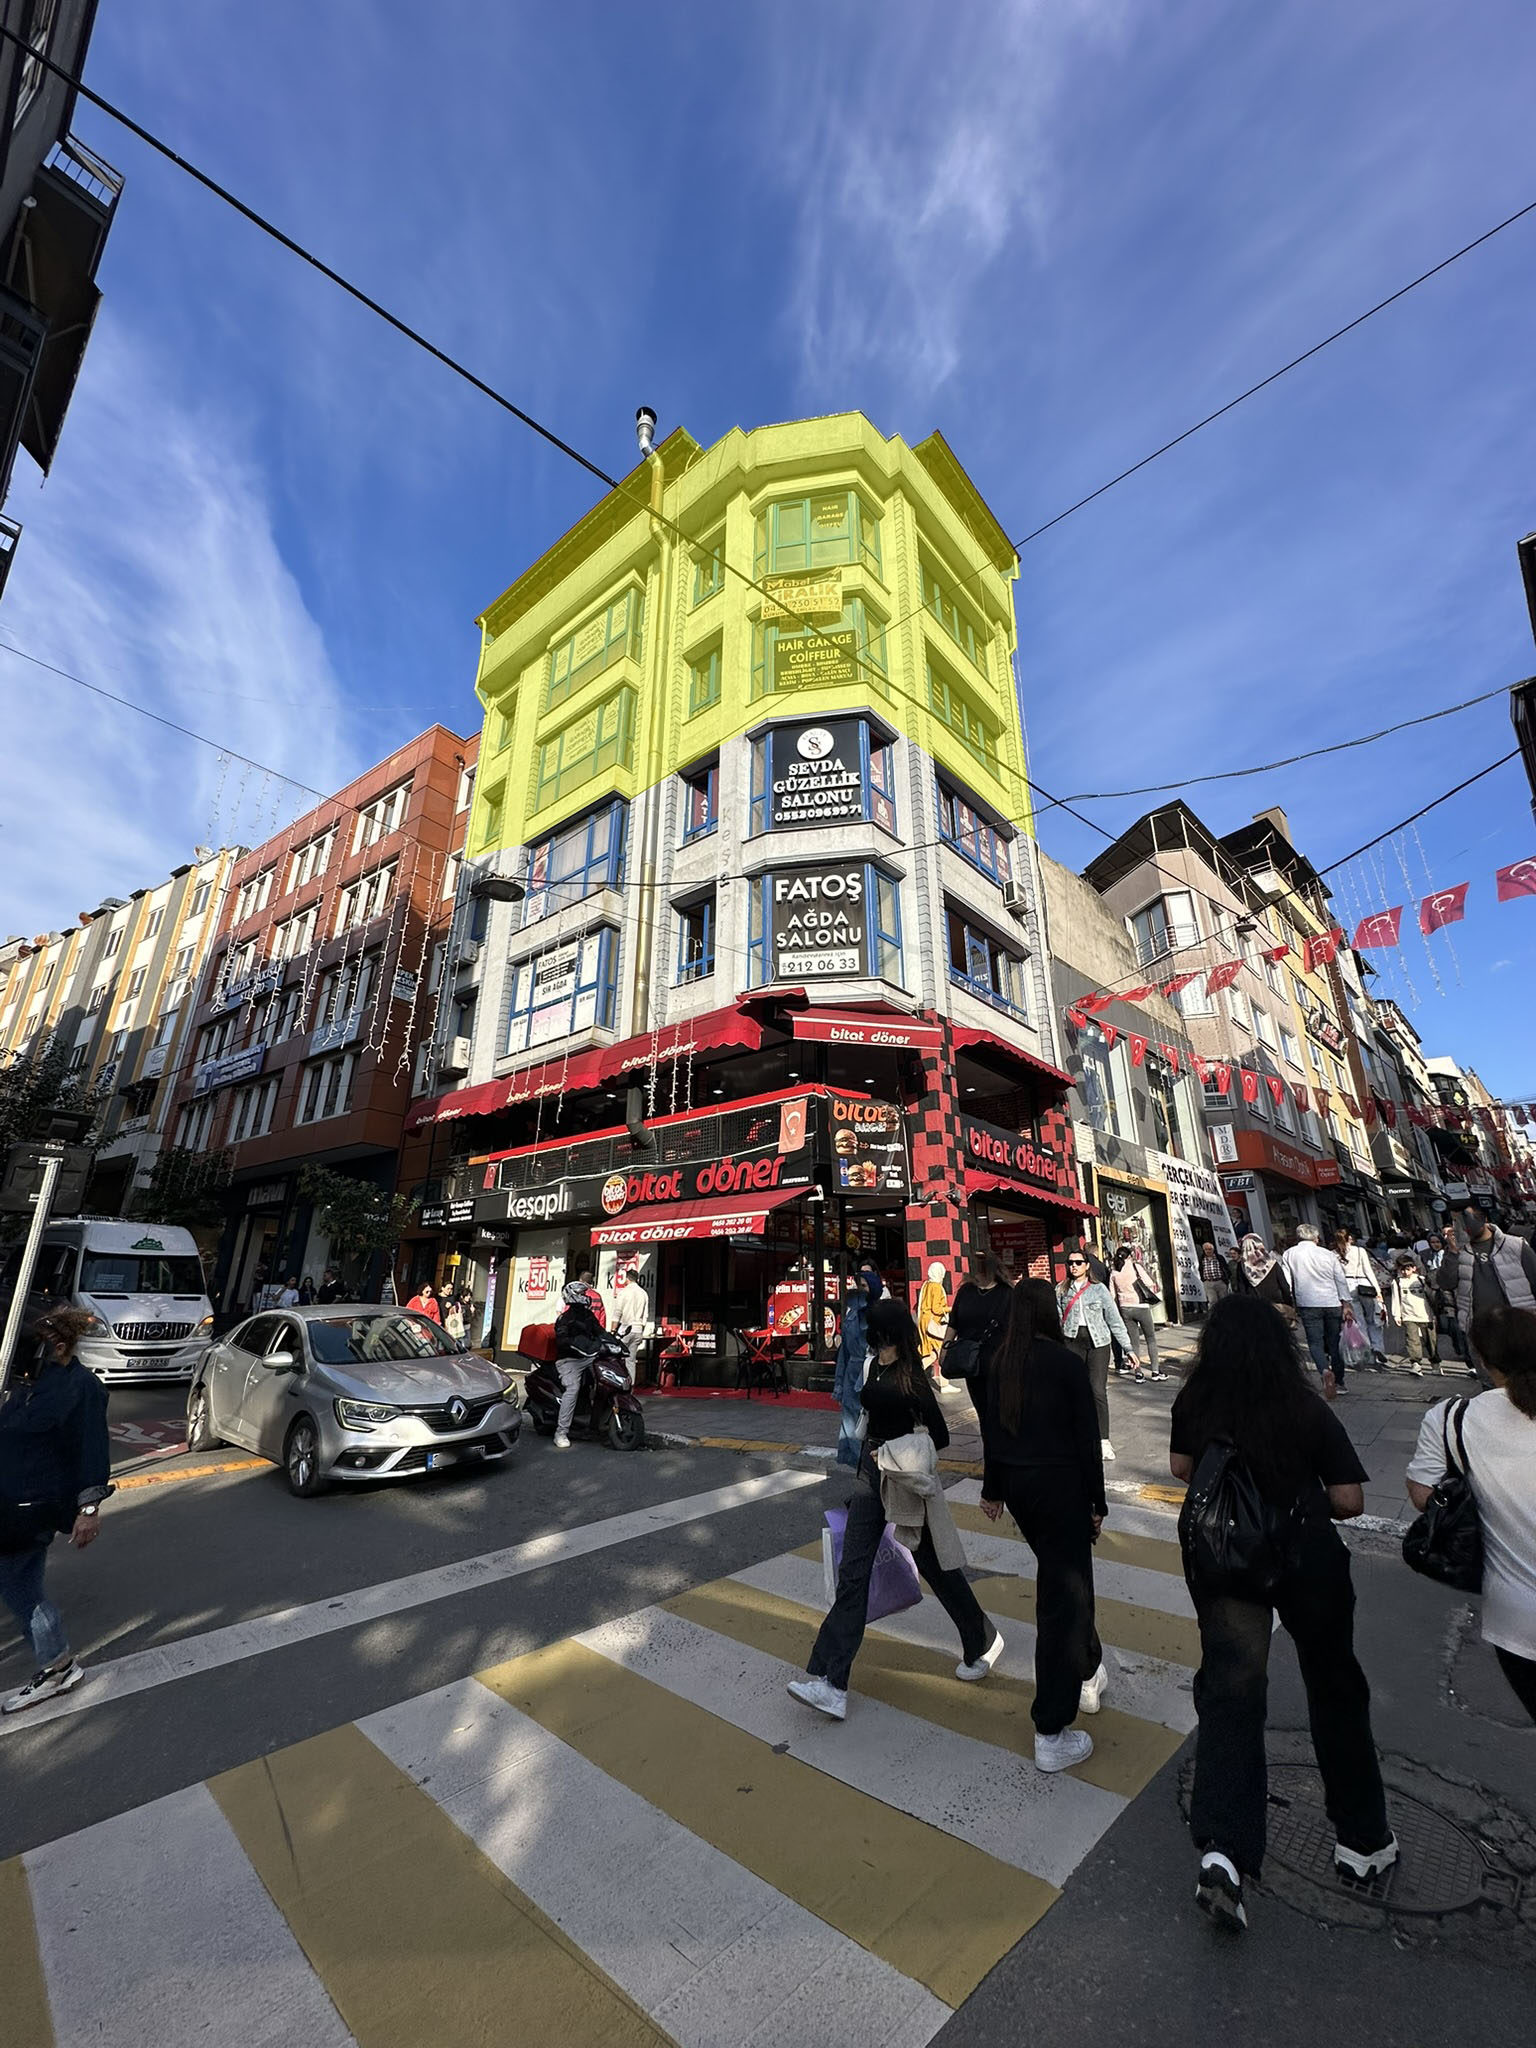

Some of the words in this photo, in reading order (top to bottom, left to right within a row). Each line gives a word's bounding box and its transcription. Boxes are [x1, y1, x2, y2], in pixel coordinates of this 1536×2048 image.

[788, 758, 845, 776] SEVDA
[773, 770, 861, 794] GÜZELLİK
[781, 788, 854, 809] SALONU
[775, 872, 862, 902] FATOŞ
[787, 908, 849, 929] AĞDA
[776, 926, 862, 948] SALONU
[787, 960, 813, 973] 212
[817, 959, 835, 971] 06
[839, 957, 856, 970] 33
[830, 1027, 865, 1041] bitat
[870, 1031, 911, 1045] döner
[970, 1127, 1011, 1167] bitat
[1016, 1143, 1058, 1181] döner
[626, 1169, 684, 1204] bitat
[696, 1155, 786, 1195] döner
[1229, 1177, 1250, 1187] FBI
[506, 1183, 569, 1221] keşaplı
[598, 1229, 637, 1244] bitat
[640, 1226, 695, 1241] döner
[530, 1267, 548, 1289] 50
